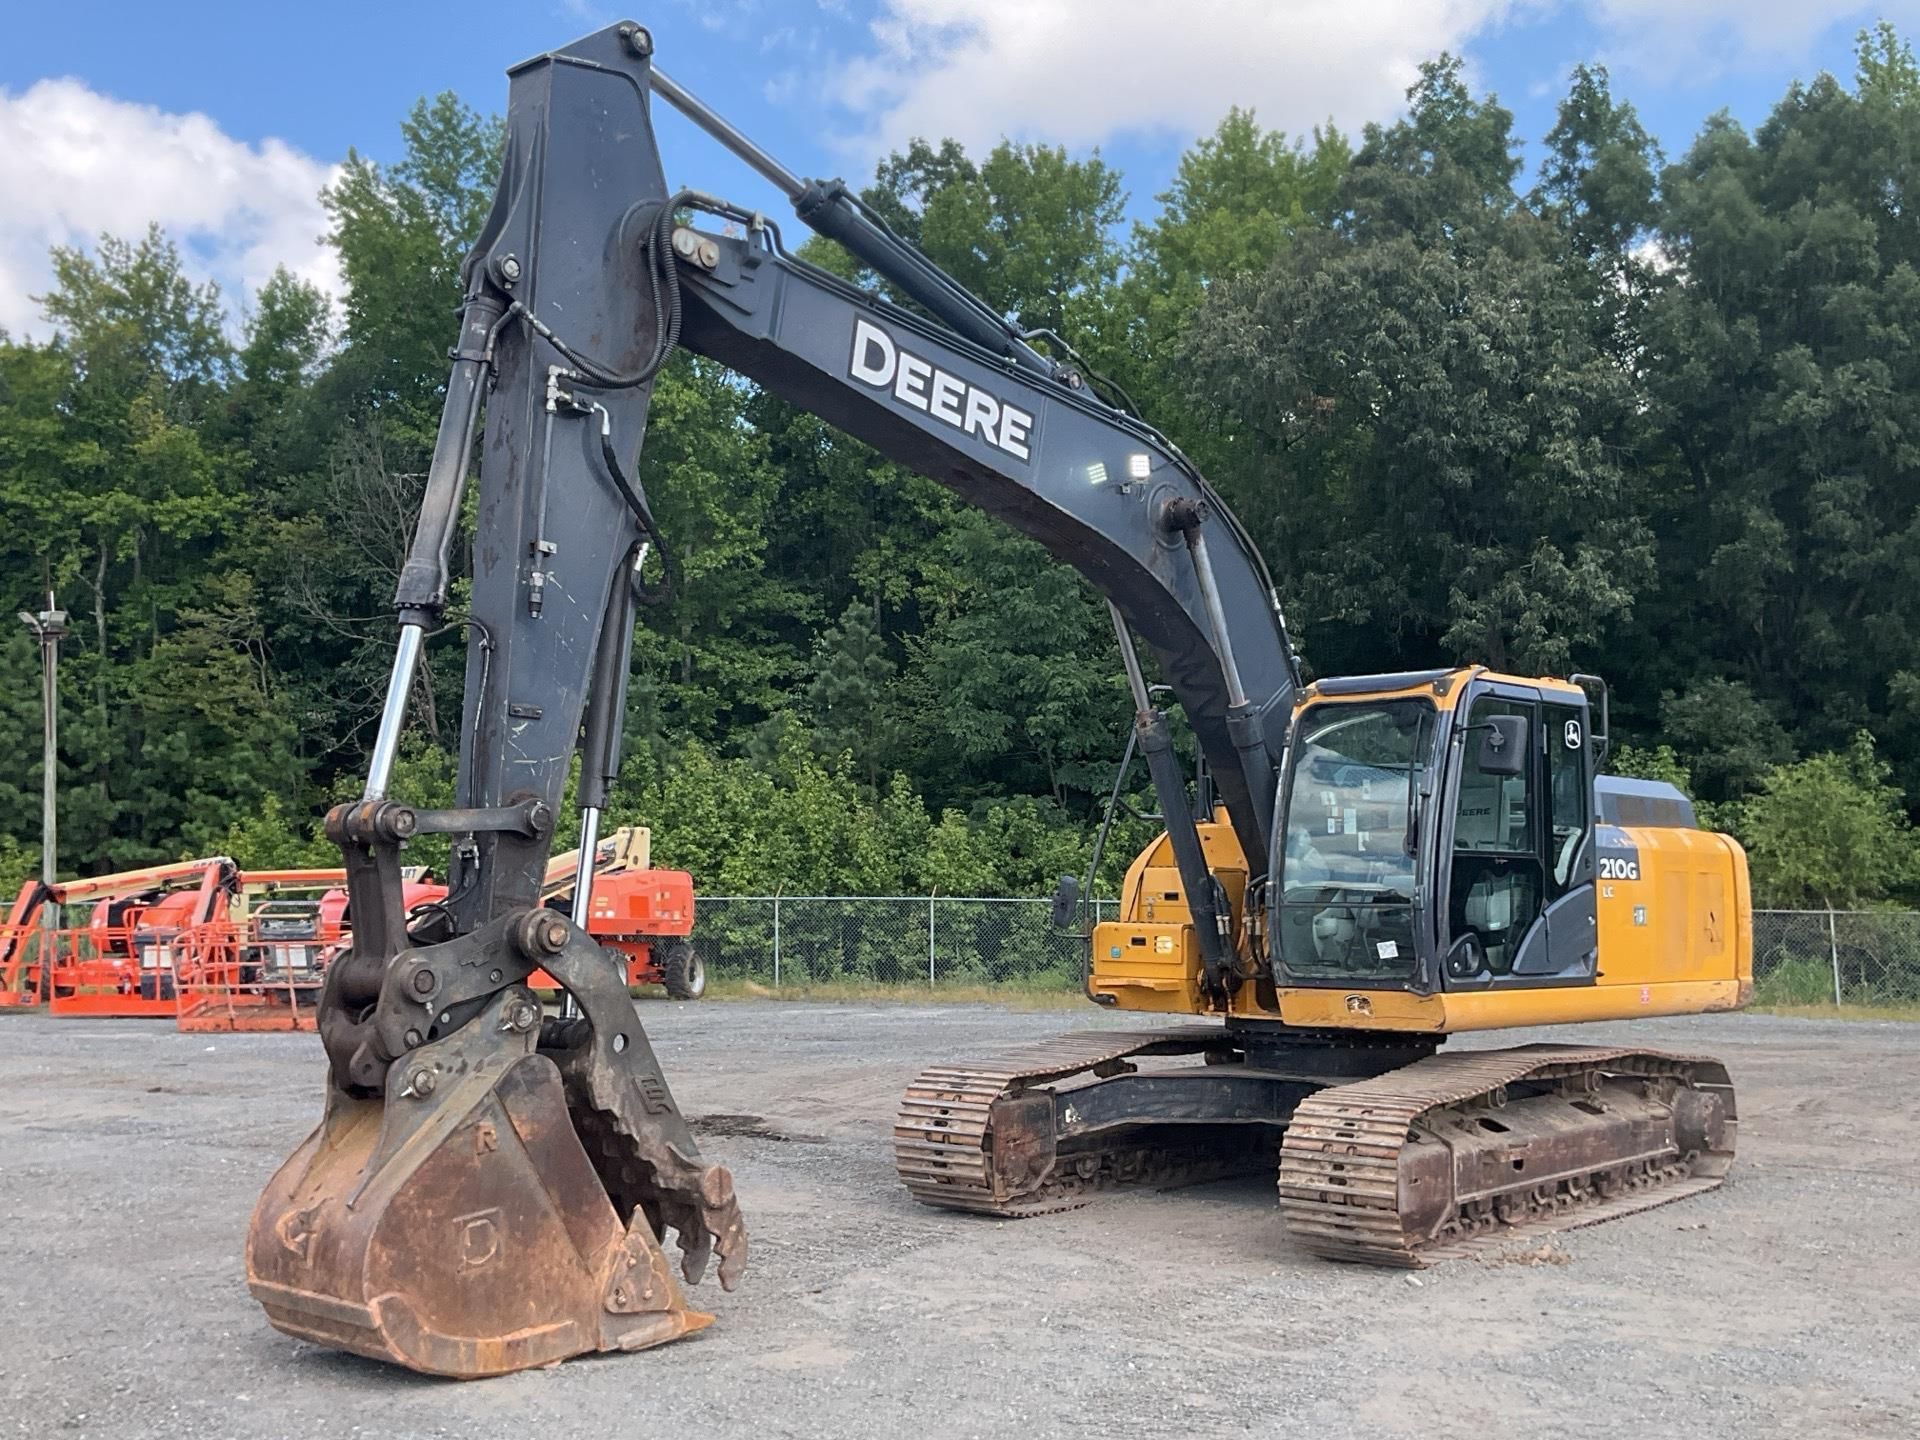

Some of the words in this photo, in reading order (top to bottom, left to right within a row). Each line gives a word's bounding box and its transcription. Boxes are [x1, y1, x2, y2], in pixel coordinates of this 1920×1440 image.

[850, 319, 1033, 460] DEERE
[1599, 857, 1638, 880] 210G
[1602, 886, 1615, 898] LC
